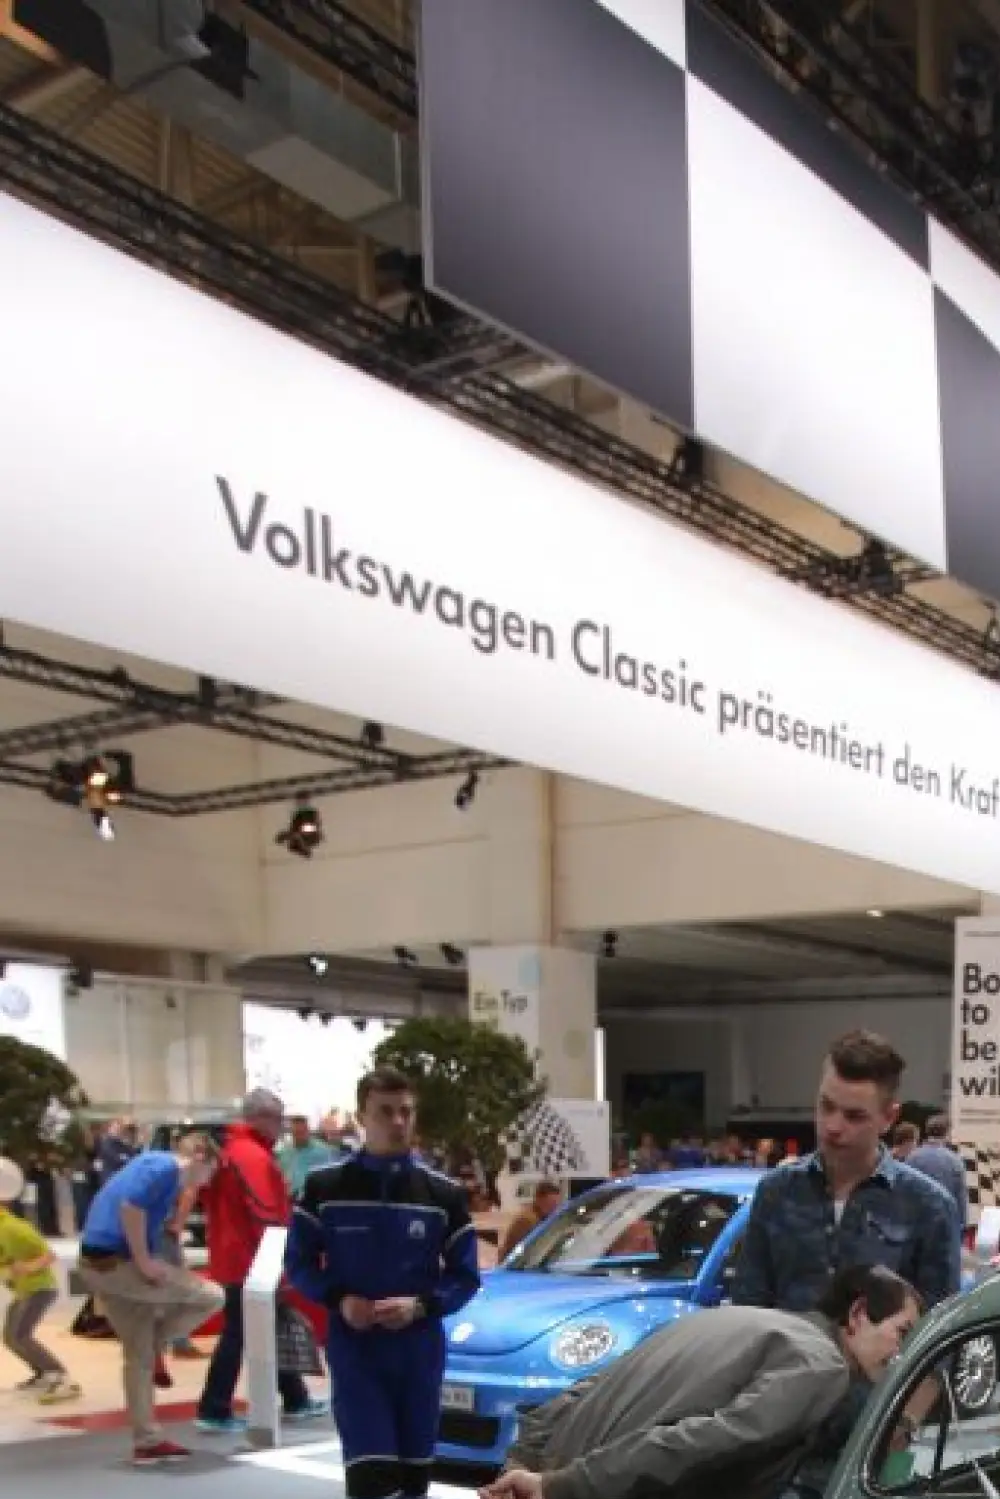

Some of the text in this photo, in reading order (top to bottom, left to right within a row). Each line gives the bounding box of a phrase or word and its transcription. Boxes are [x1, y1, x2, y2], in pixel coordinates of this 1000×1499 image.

[214, 474, 556, 661] Volkswagen
[571, 618, 706, 715] Classic
[716, 689, 884, 777] präsentiert
[893, 741, 941, 797] den
[960, 998, 990, 1026] to
[959, 1029, 997, 1061] be
